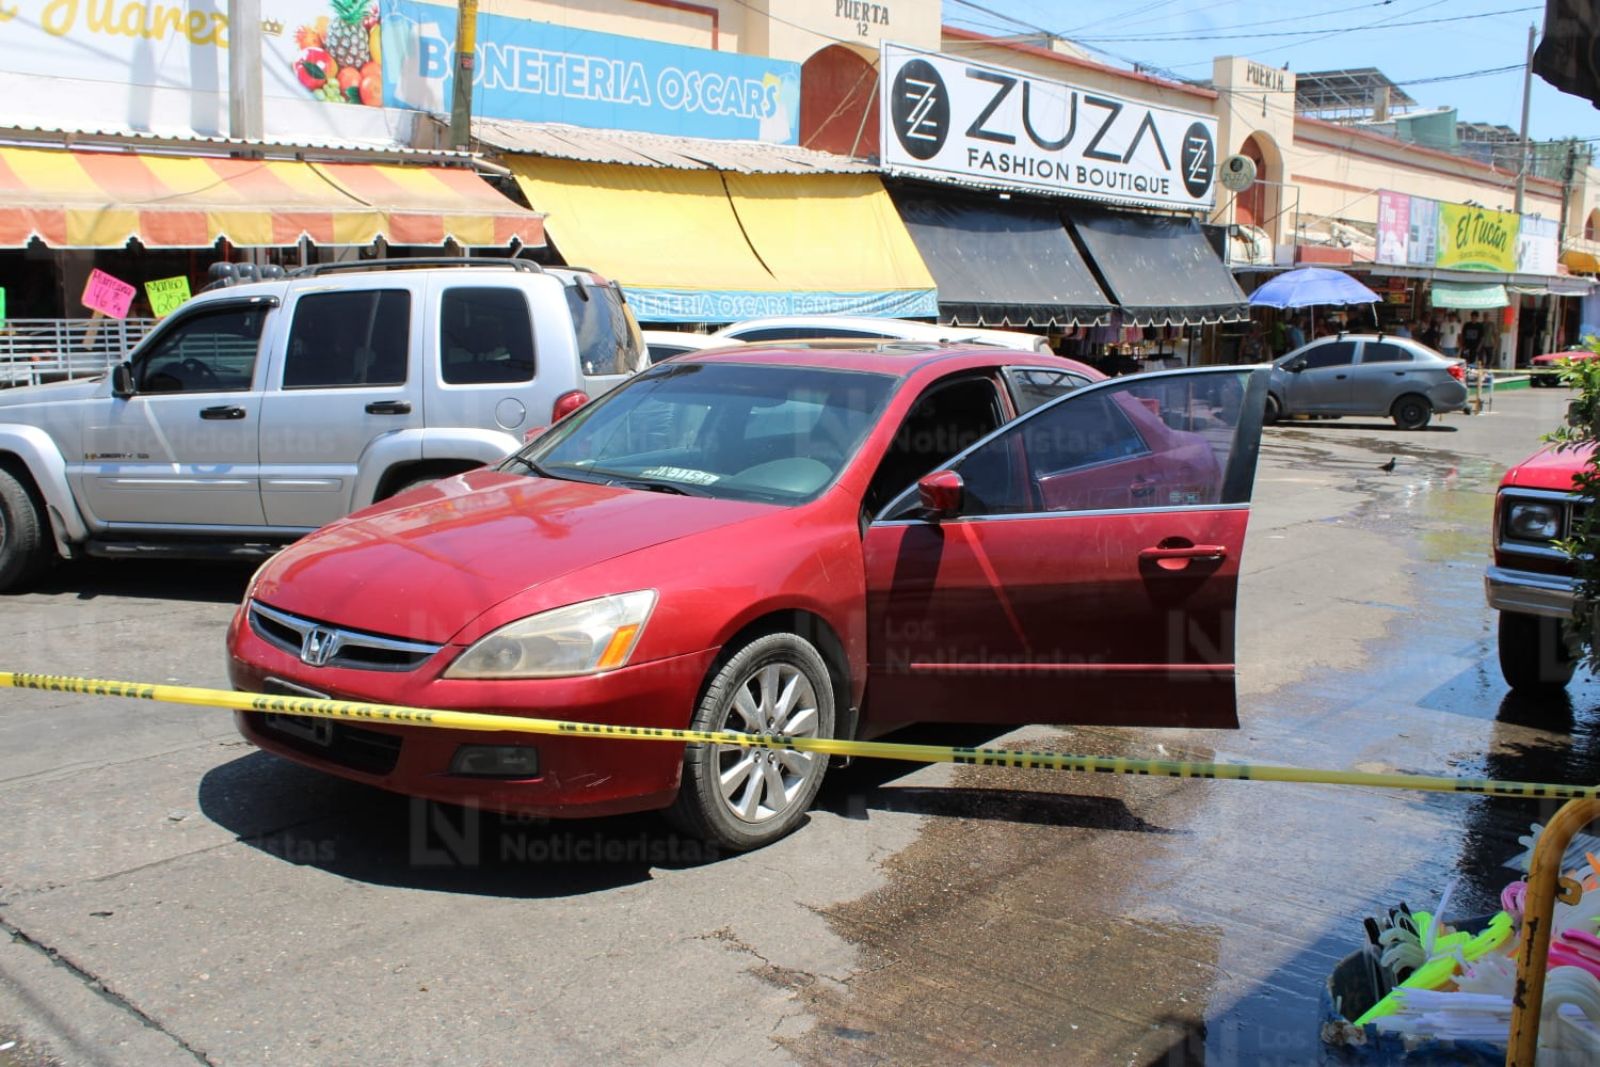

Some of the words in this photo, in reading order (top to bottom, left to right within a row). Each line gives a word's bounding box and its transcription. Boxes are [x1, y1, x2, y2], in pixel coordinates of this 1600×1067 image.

[835, 0, 890, 26] PUERTA
[856, 22, 869, 37] 12
[656, 67, 778, 120] OSCARS
[964, 66, 1173, 171] ZUZA
[967, 147, 1070, 181] FASHION
[1076, 165, 1170, 195] BOUTIQUE
[1455, 211, 1472, 250] El
[719, 295, 788, 317] OSCARS
